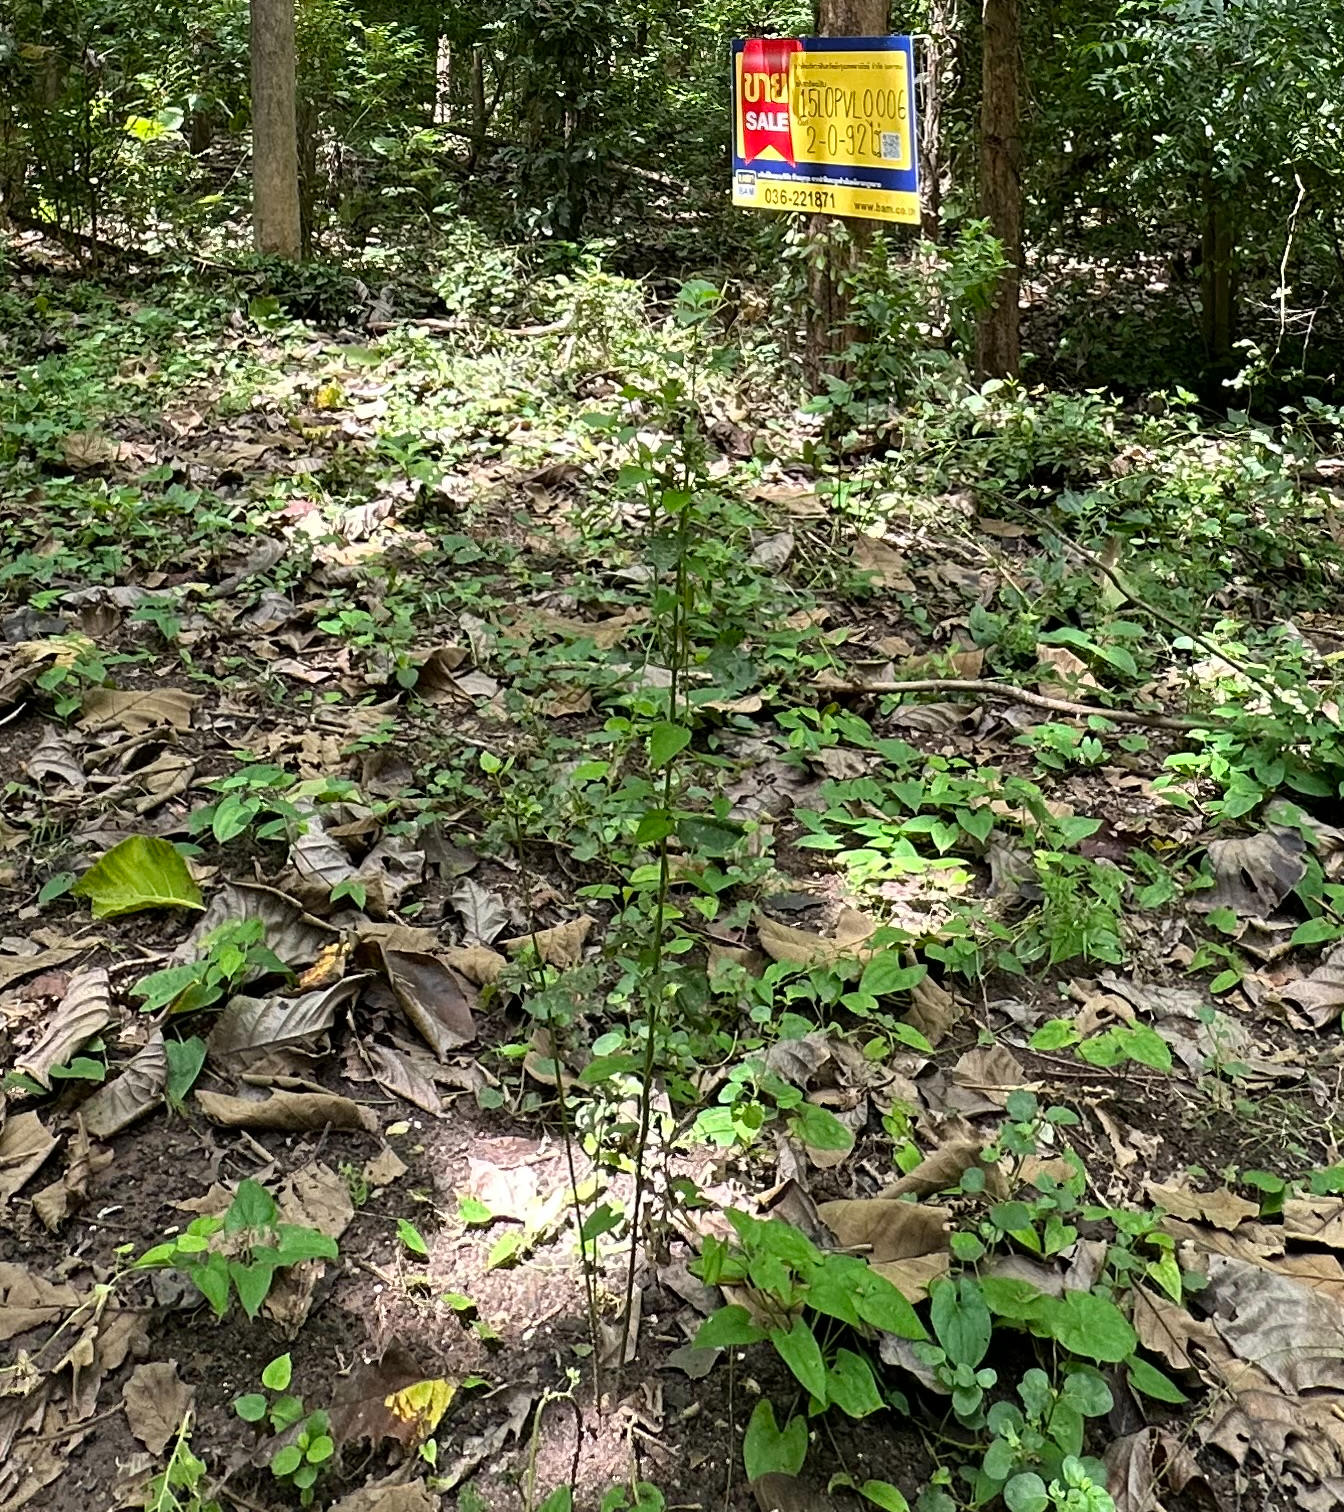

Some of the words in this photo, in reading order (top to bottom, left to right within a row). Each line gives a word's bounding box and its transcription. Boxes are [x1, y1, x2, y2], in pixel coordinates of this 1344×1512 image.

[744, 72, 789, 104] ขาย
[745, 110, 790, 132] SALE
[764, 188, 836, 209] 036-221871
